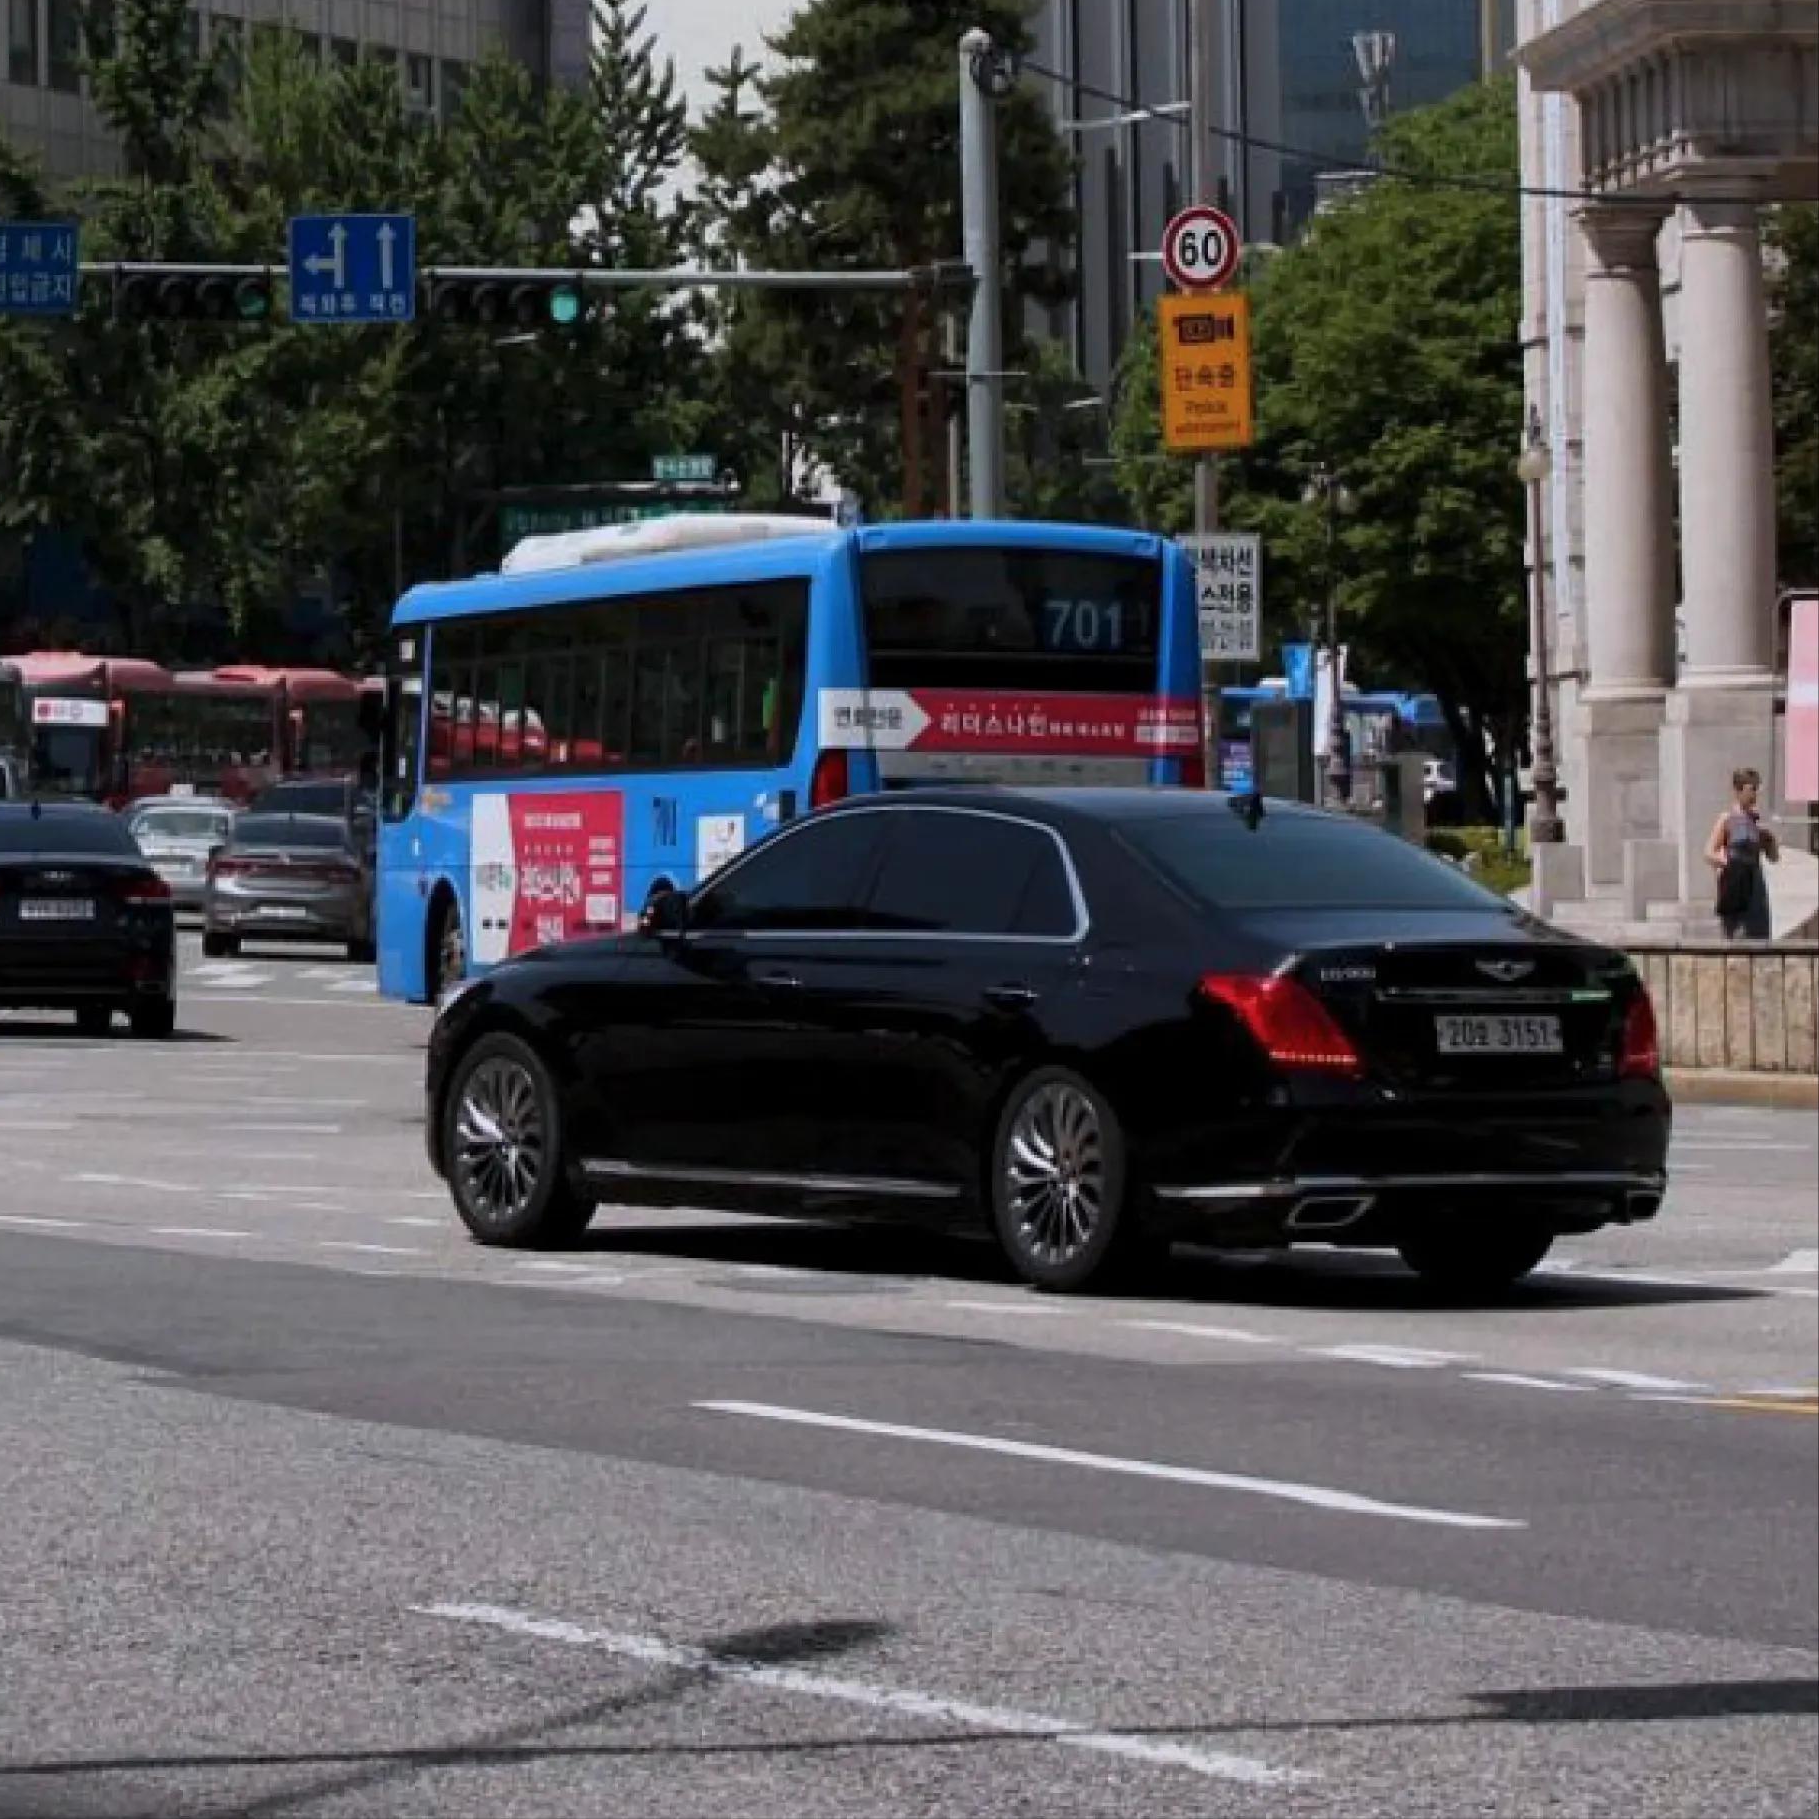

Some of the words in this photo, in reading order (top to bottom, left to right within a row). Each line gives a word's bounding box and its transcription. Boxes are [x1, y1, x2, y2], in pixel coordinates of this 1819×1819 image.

[1180, 230, 1223, 268] 60
[1044, 599, 1122, 648] 701
[1499, 1019, 1551, 1046] 3151
